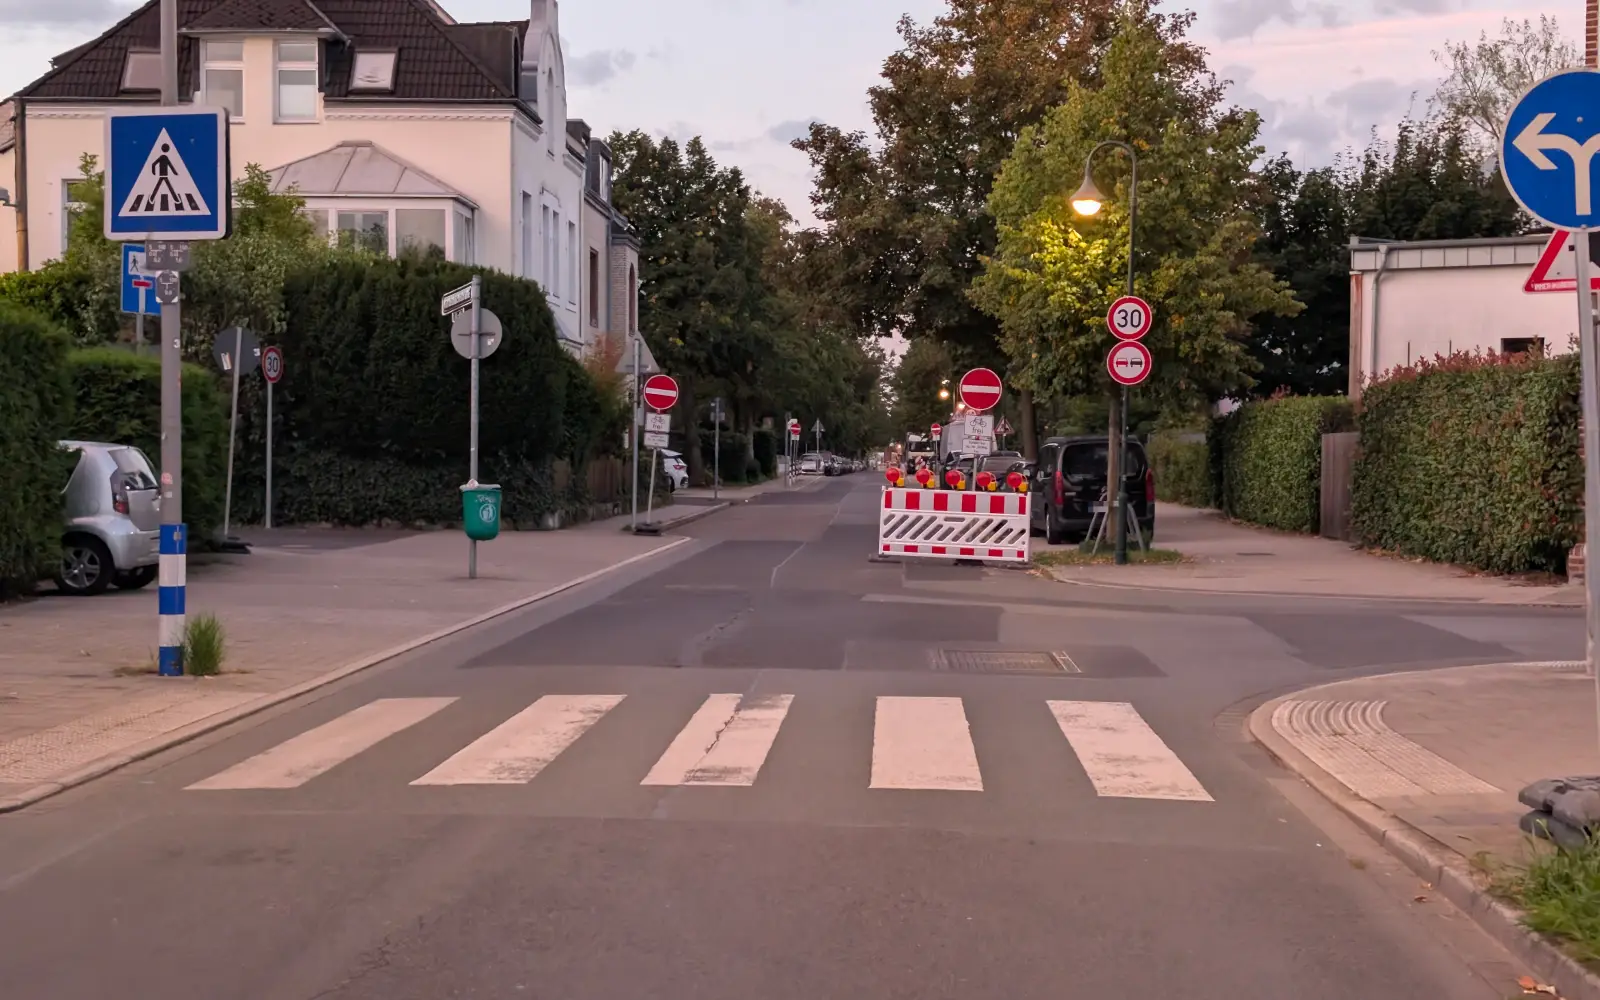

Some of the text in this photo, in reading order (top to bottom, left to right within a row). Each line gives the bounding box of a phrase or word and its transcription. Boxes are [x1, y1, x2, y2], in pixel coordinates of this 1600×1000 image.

[1117, 309, 1142, 328] 30
[266, 356, 279, 373] 30
[972, 426, 984, 434] frei
